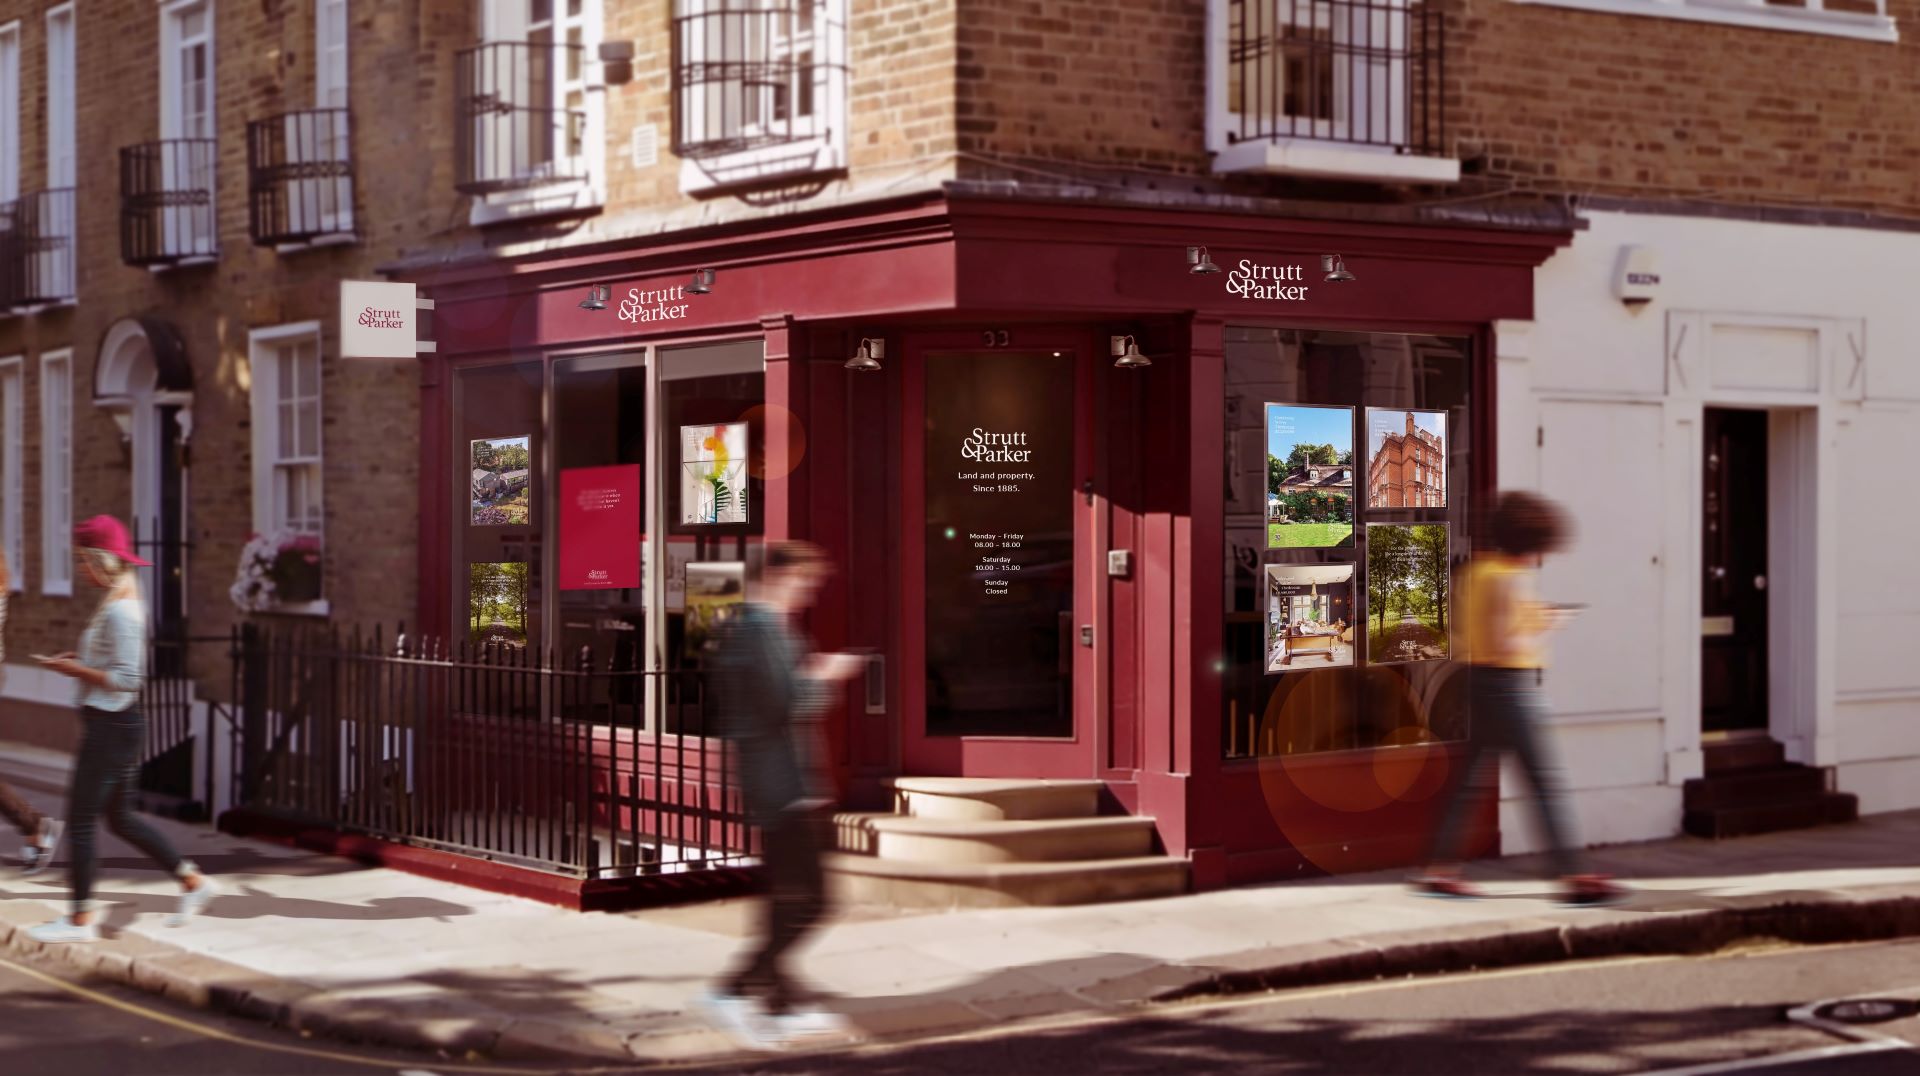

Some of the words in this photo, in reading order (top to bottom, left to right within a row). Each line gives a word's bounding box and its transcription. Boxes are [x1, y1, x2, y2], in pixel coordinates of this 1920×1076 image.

[1238, 259, 1303, 281] Strutt
[628, 285, 685, 306] Strutt
[365, 306, 401, 319] Strutt
[972, 427, 1028, 446] Strutt
[958, 472, 978, 480] Land
[980, 472, 995, 480] and
[997, 472, 1036, 481] property.
[973, 484, 995, 493] Since
[997, 485, 1021, 493] 1885.
[969, 533, 997, 541] Monday
[1003, 533, 1024, 541] Friday
[982, 556, 1011, 564] Saturday
[984, 579, 1009, 587] Sunday
